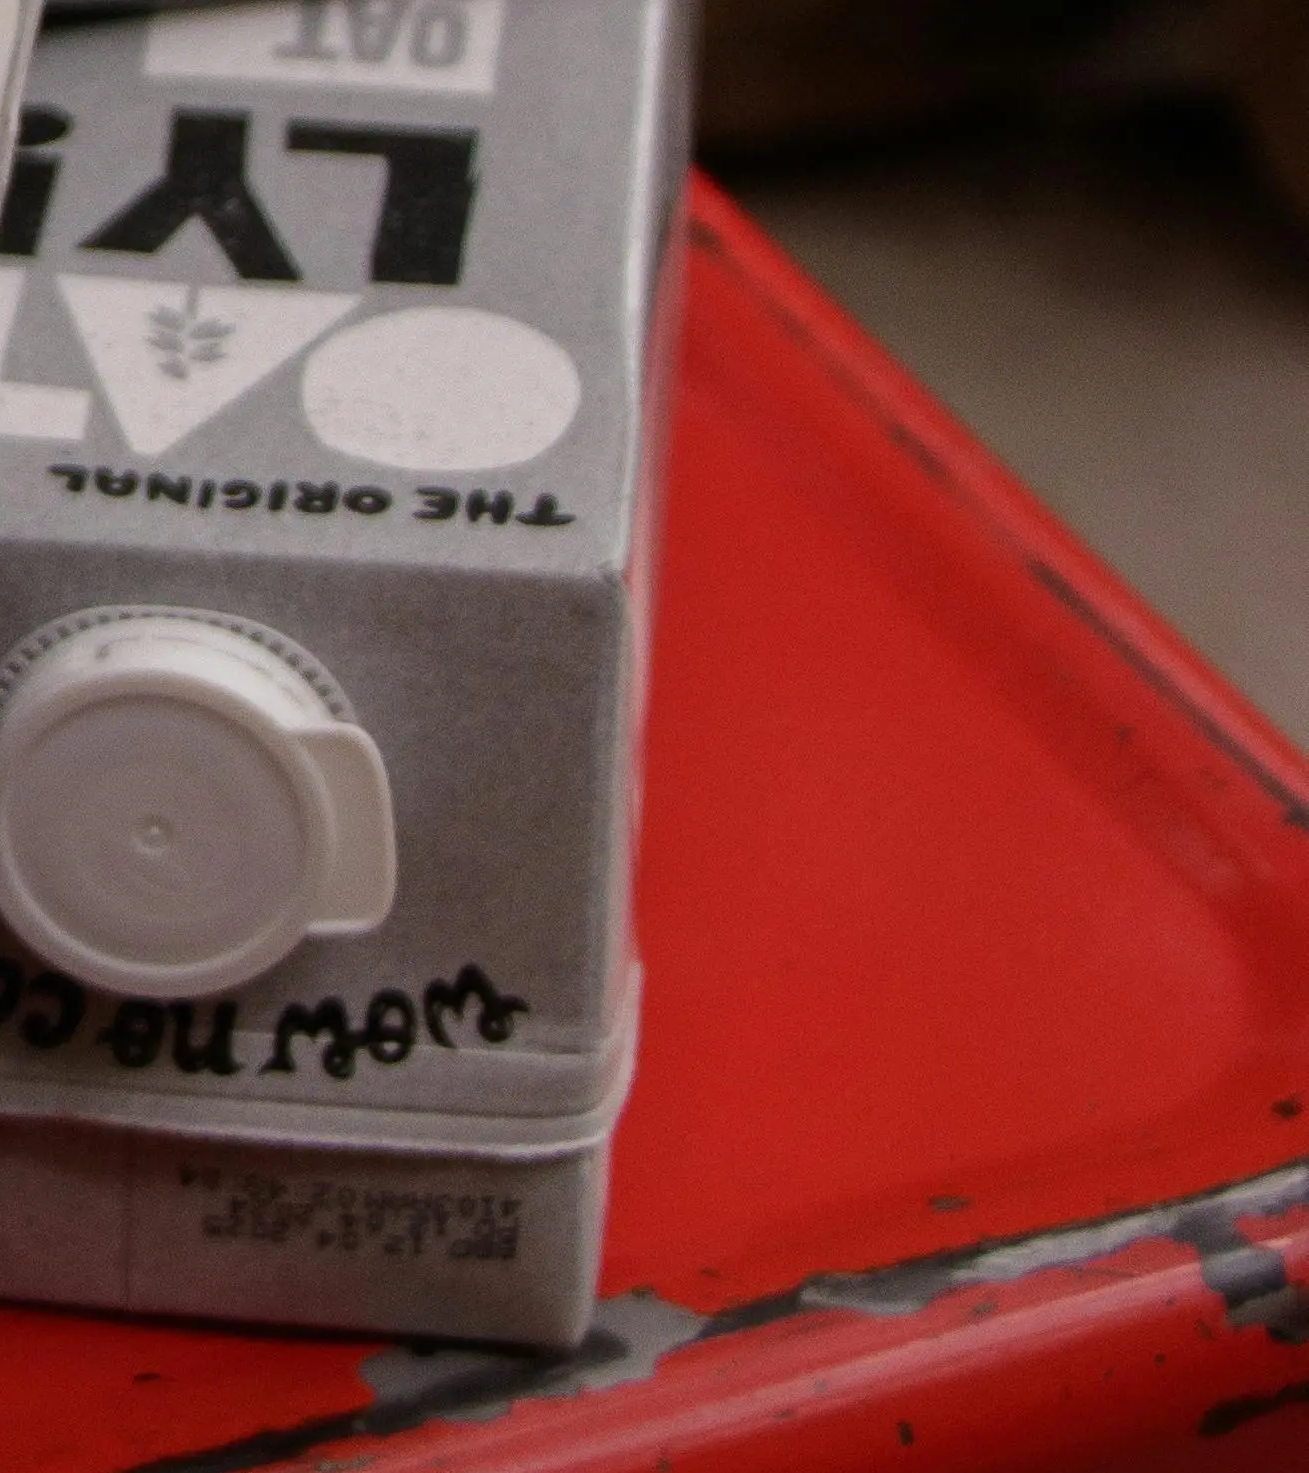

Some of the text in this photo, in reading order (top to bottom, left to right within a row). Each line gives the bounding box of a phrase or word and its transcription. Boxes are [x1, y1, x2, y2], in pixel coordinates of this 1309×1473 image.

[48, 462, 577, 529] THE ORIGINAL
[109, 994, 245, 1078] no
[258, 962, 529, 1080] wow
